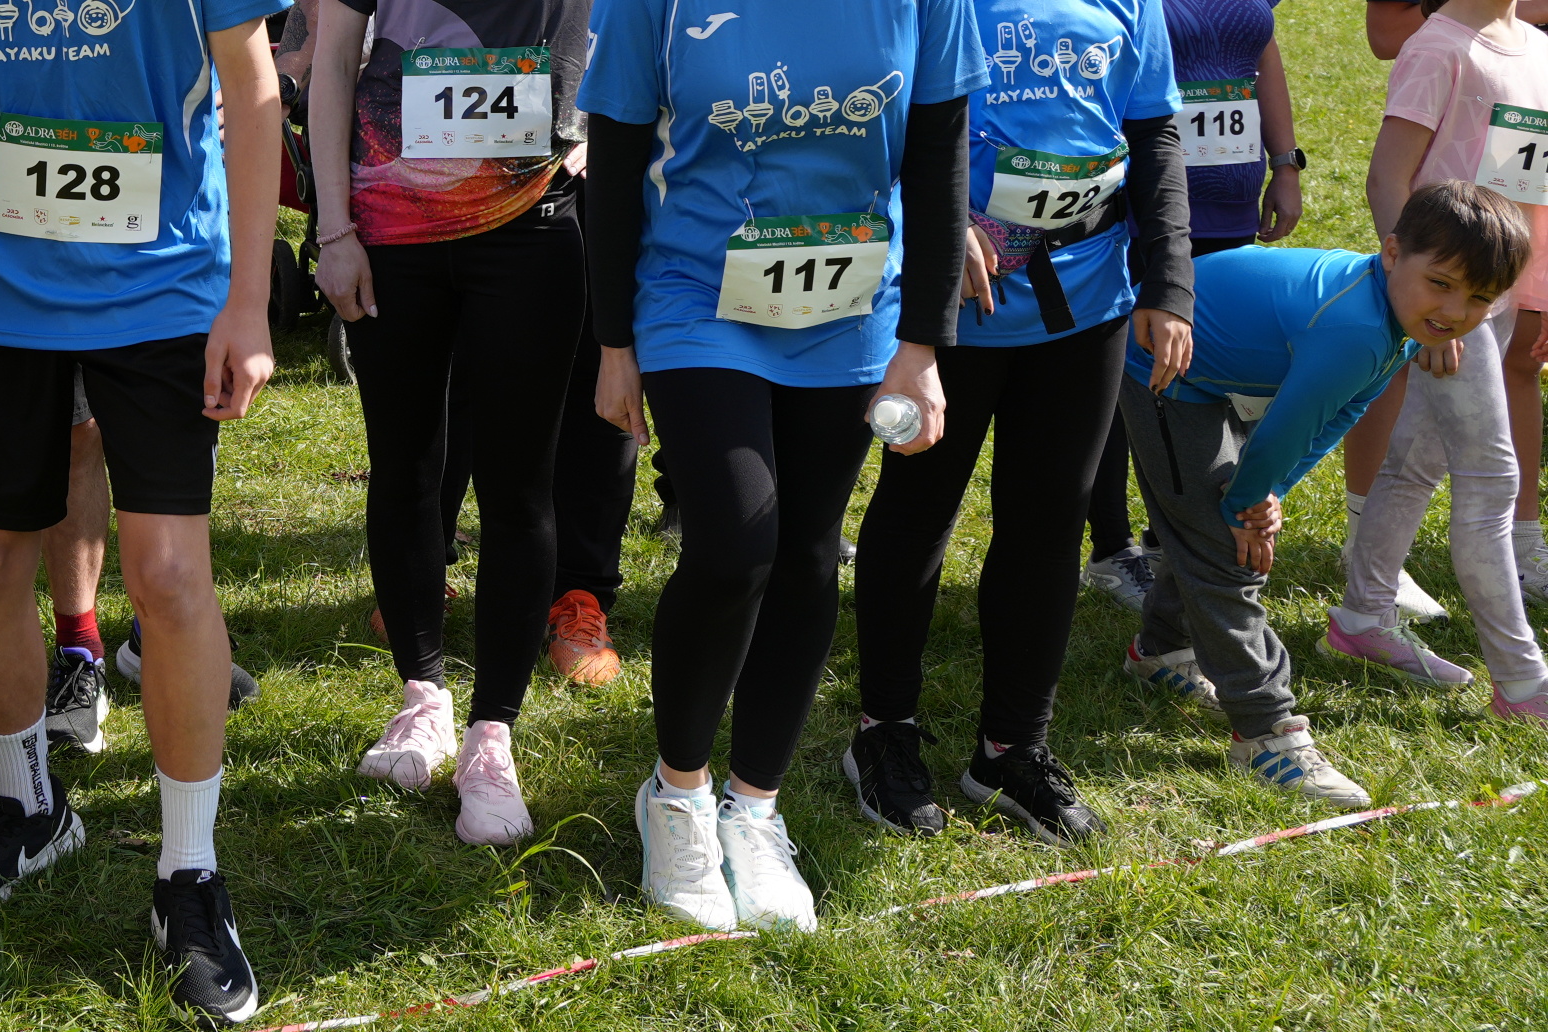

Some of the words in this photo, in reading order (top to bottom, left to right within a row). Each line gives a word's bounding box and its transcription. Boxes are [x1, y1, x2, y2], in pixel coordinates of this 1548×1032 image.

[63, 43, 110, 61] TEAM
[435, 86, 518, 119] 124
[986, 86, 1058, 105] KAYAKU
[813, 125, 867, 137] TEAM
[1190, 110, 1244, 137] 118
[26, 160, 121, 201] 128
[1027, 185, 1101, 219] 122
[763, 257, 853, 293] 117
